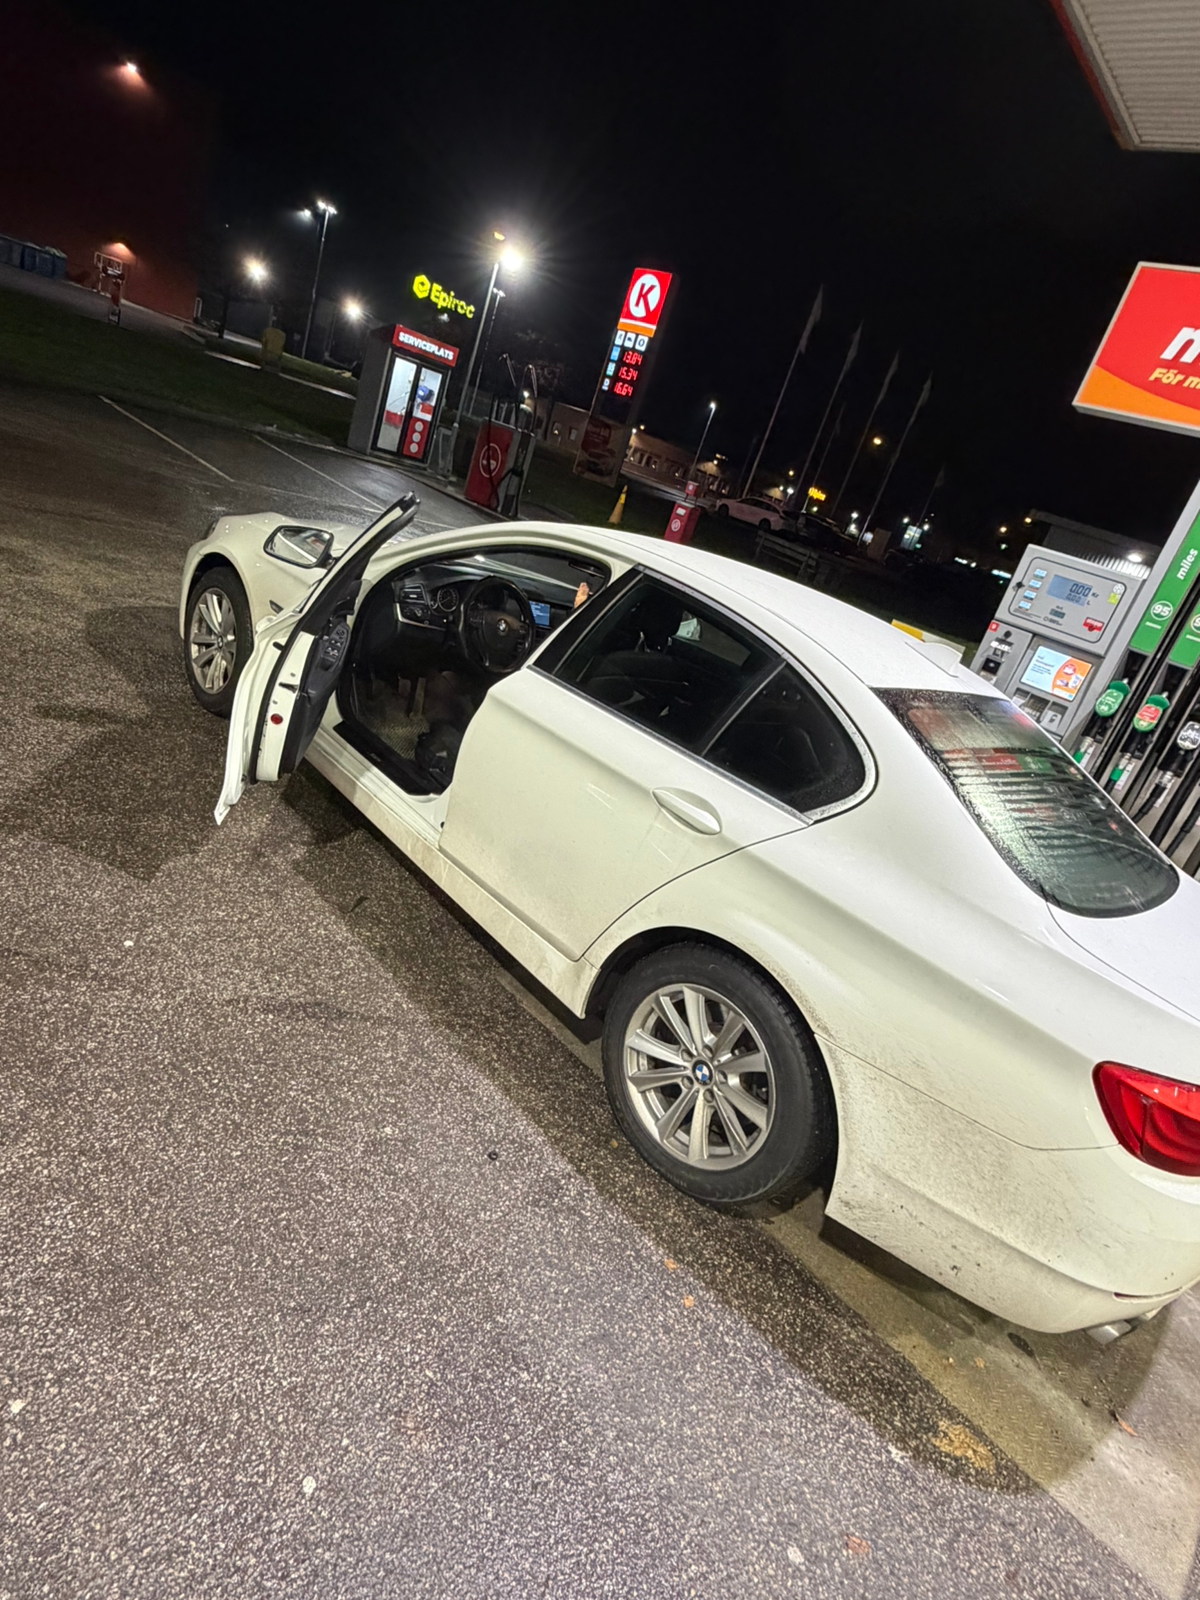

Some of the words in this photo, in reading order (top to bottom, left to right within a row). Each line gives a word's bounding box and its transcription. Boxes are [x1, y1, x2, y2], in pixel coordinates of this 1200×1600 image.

[430, 282, 476, 319] Epiroc
[634, 282, 657, 313] K
[398, 331, 454, 361] SERVICEPLATS
[623, 351, 643, 366] 13.84
[618, 366, 638, 381] 15.34
[1149, 368, 1184, 385] För
[613, 382, 634, 397] 16.64
[1177, 548, 1198, 580] miles
[1069, 582, 1092, 597] 0.00
[1152, 604, 1171, 617] 95
